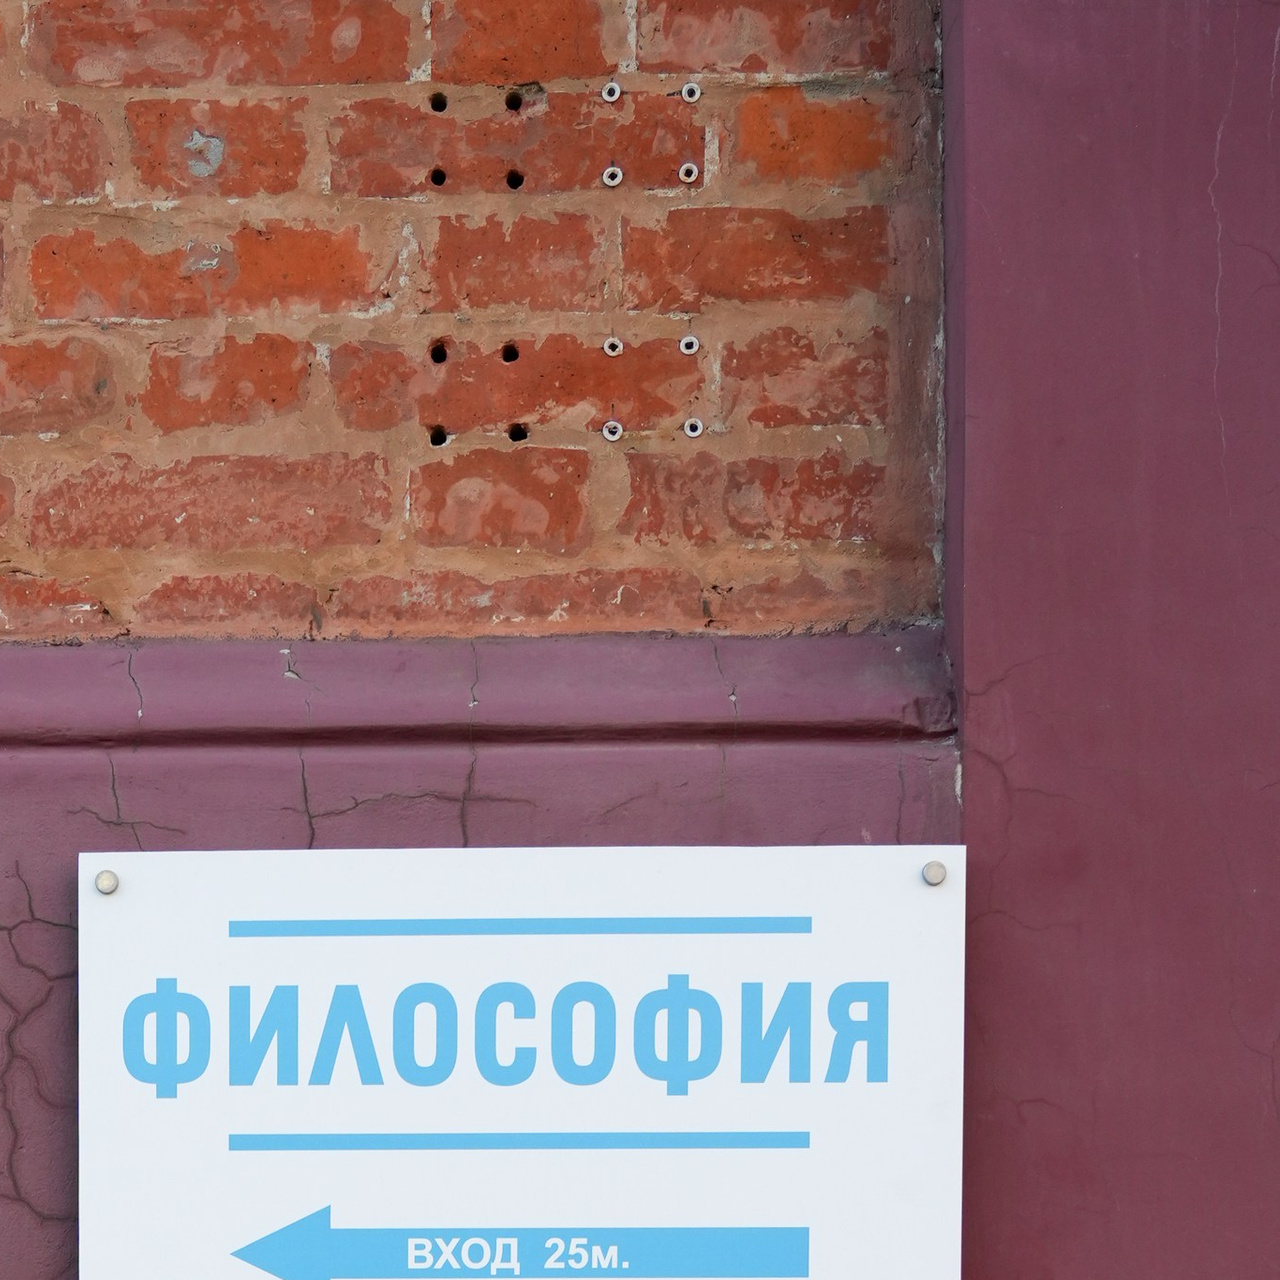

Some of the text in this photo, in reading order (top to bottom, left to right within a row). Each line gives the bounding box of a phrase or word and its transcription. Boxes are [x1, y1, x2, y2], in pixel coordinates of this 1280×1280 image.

[122, 972, 890, 1099] ФИЛОСОФИЯ
[407, 1238, 630, 1274] ВХОД 25м.
